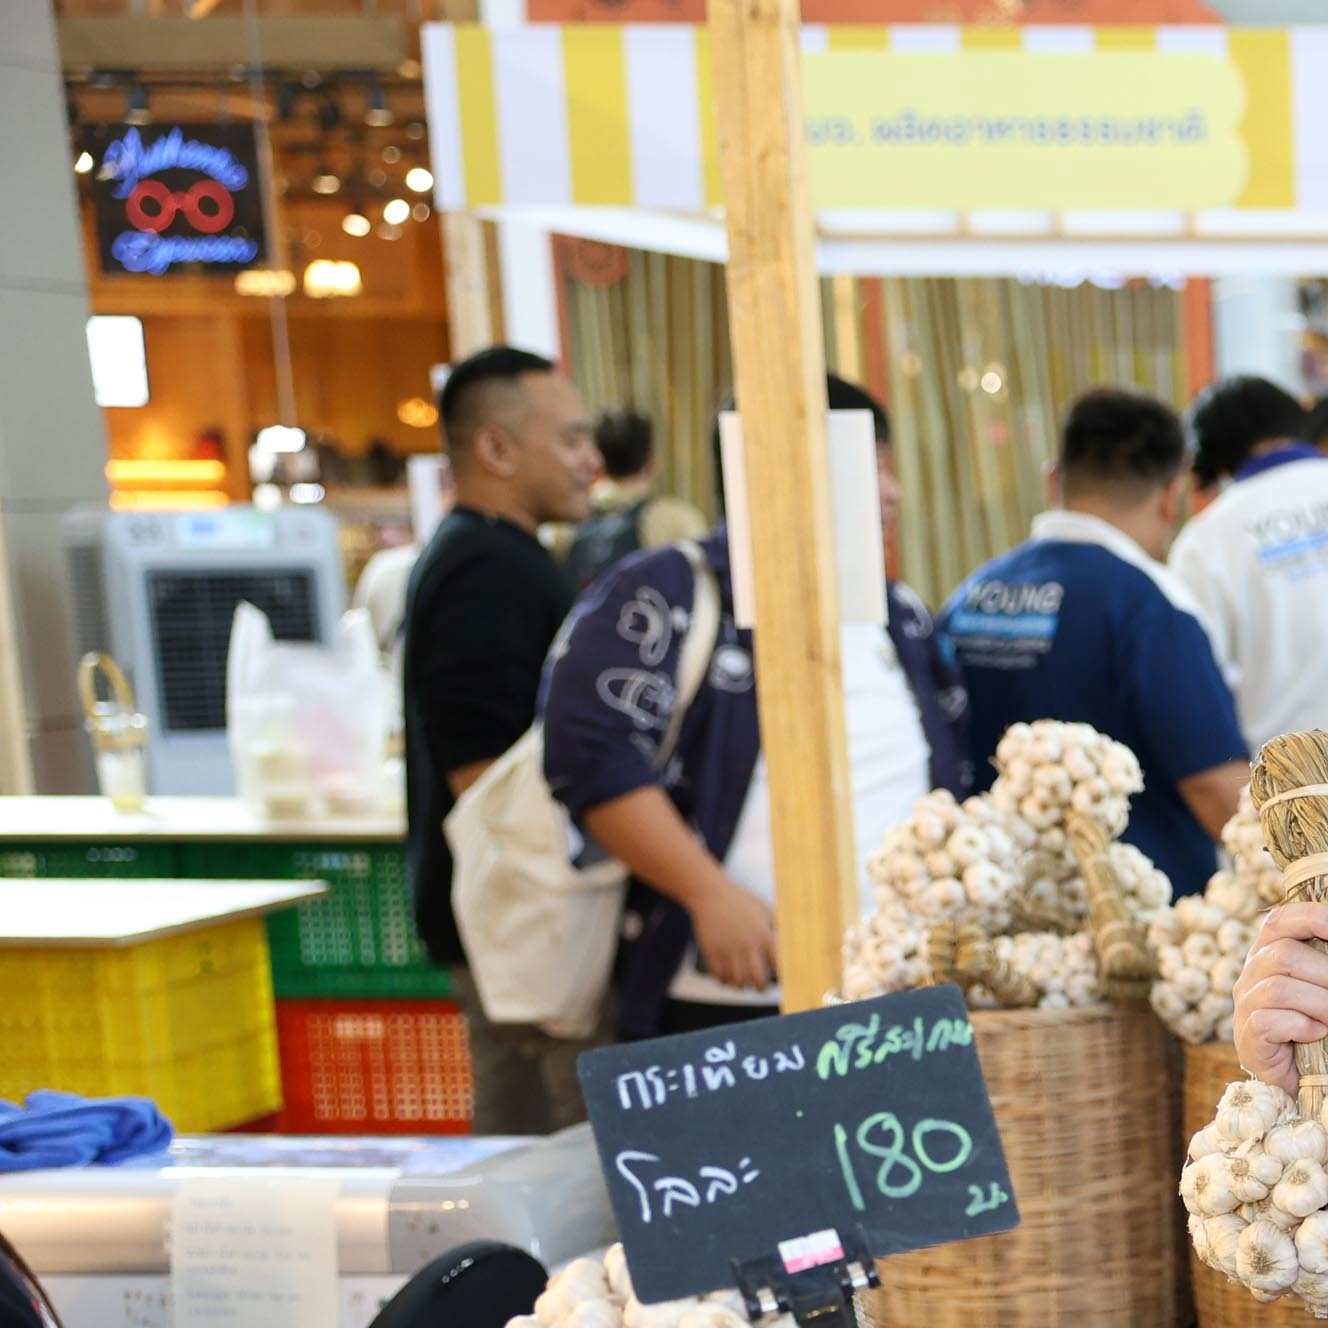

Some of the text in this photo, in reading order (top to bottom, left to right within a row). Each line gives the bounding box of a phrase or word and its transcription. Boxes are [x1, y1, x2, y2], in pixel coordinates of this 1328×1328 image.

[617, 1040, 806, 1110] กระเทียม
[833, 1111, 973, 1212] 180
